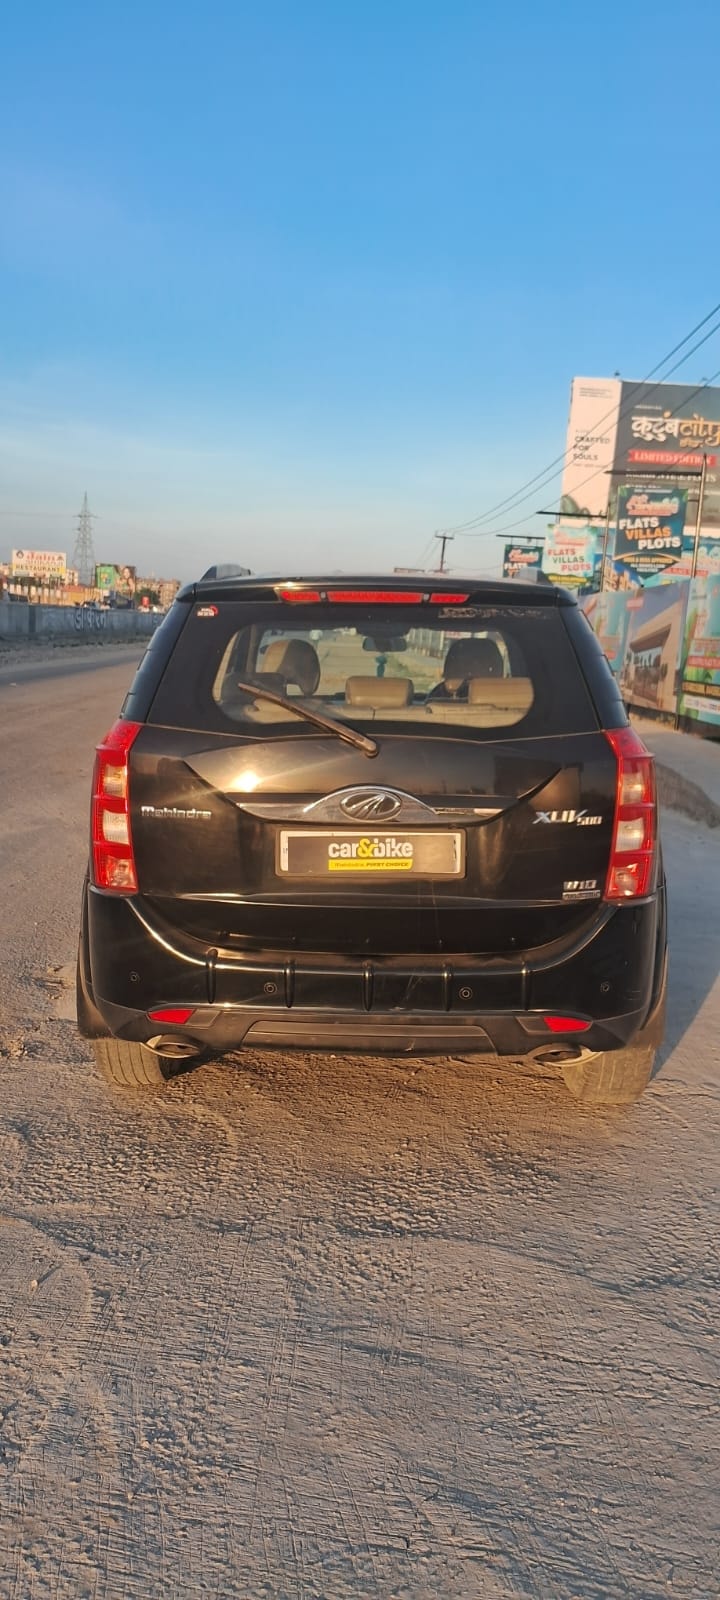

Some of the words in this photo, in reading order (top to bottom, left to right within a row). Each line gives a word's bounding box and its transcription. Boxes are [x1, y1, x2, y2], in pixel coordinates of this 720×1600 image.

[619, 517, 659, 530] FLATS
[625, 527, 671, 540] VILLAS
[638, 537, 681, 550] PLOTS
[547, 548, 576, 556] FLATS
[552, 555, 585, 563] VILLAS
[560, 563, 591, 571] PLOTS
[328, 838, 413, 858] car&bike
